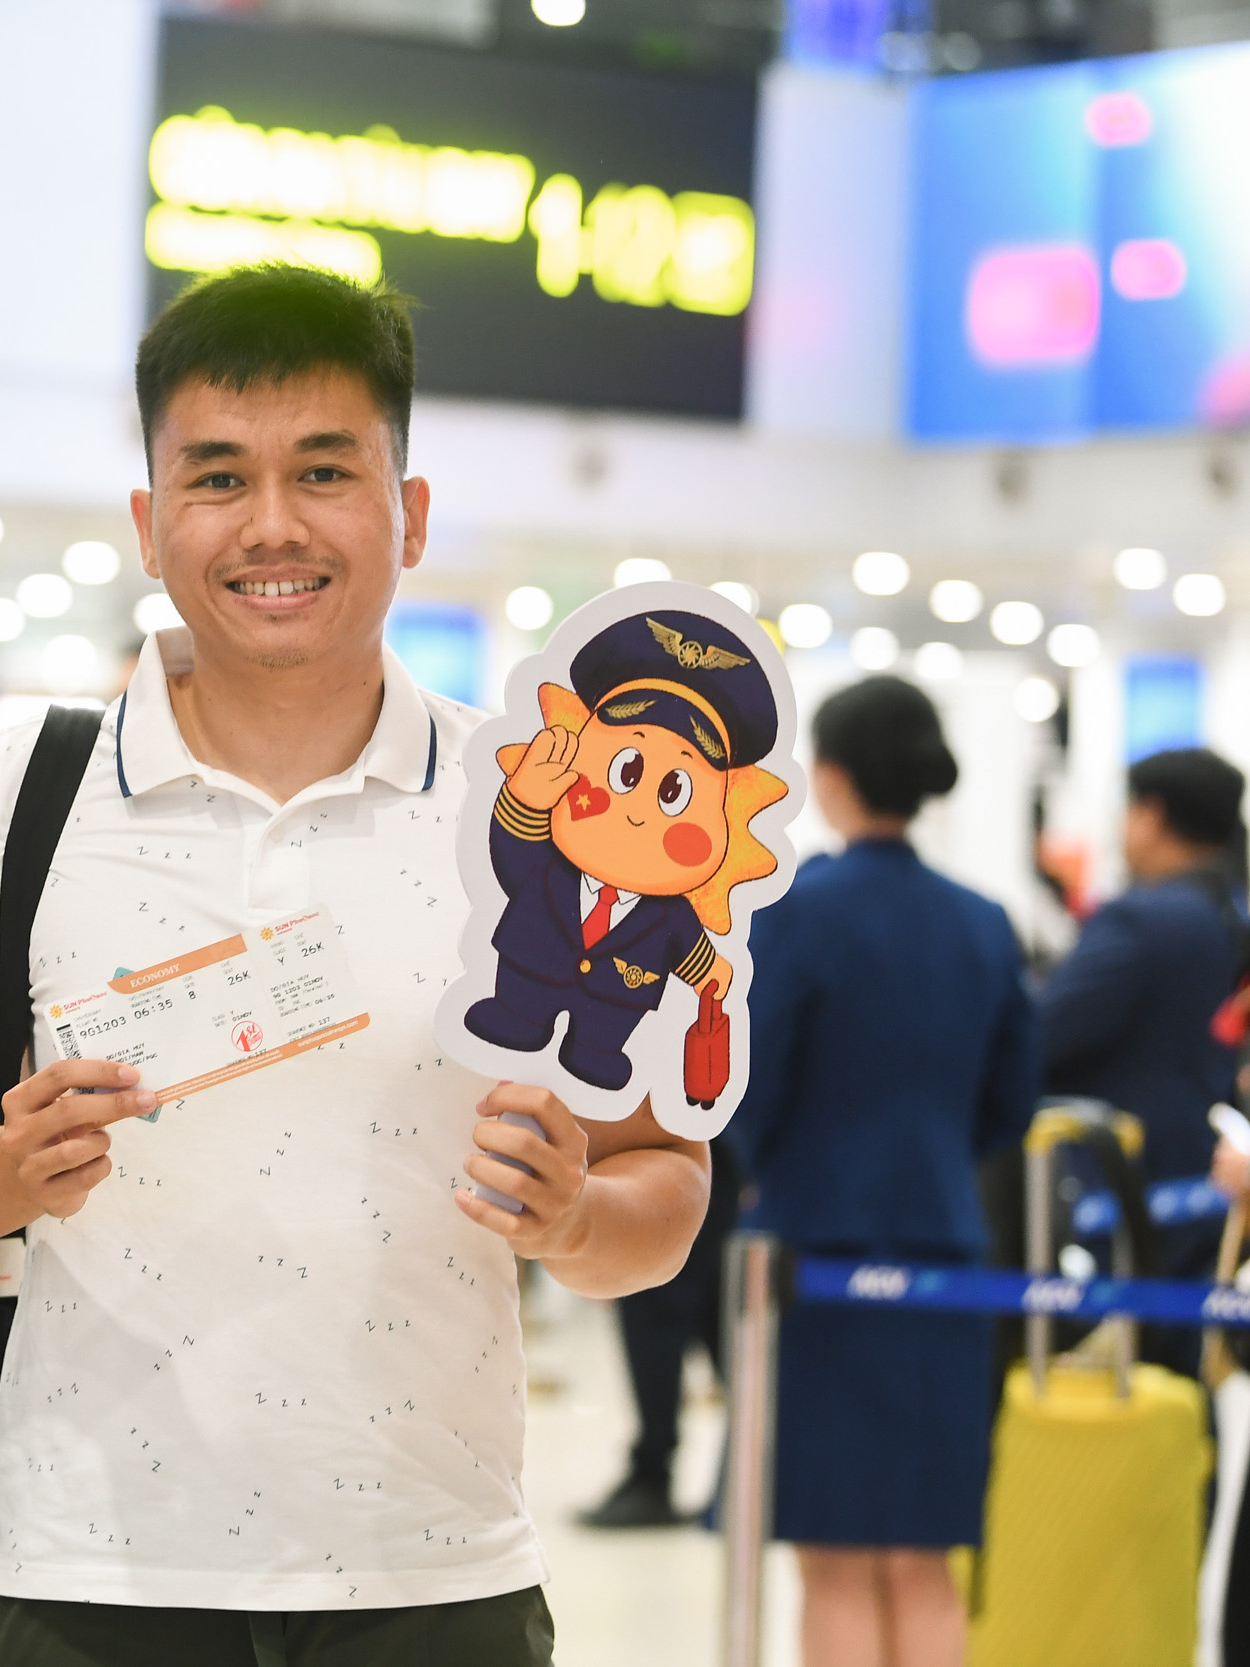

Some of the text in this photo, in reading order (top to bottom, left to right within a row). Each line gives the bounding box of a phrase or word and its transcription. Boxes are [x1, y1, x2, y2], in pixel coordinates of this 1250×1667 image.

[129, 963, 180, 988] ECONOMY
[227, 970, 251, 986] 26K
[276, 956, 285, 966] Y
[301, 941, 325, 958] 26K
[79, 1016, 127, 1040] 9G1203
[134, 998, 173, 1019] 06:35
[188, 990, 196, 1000] 8
